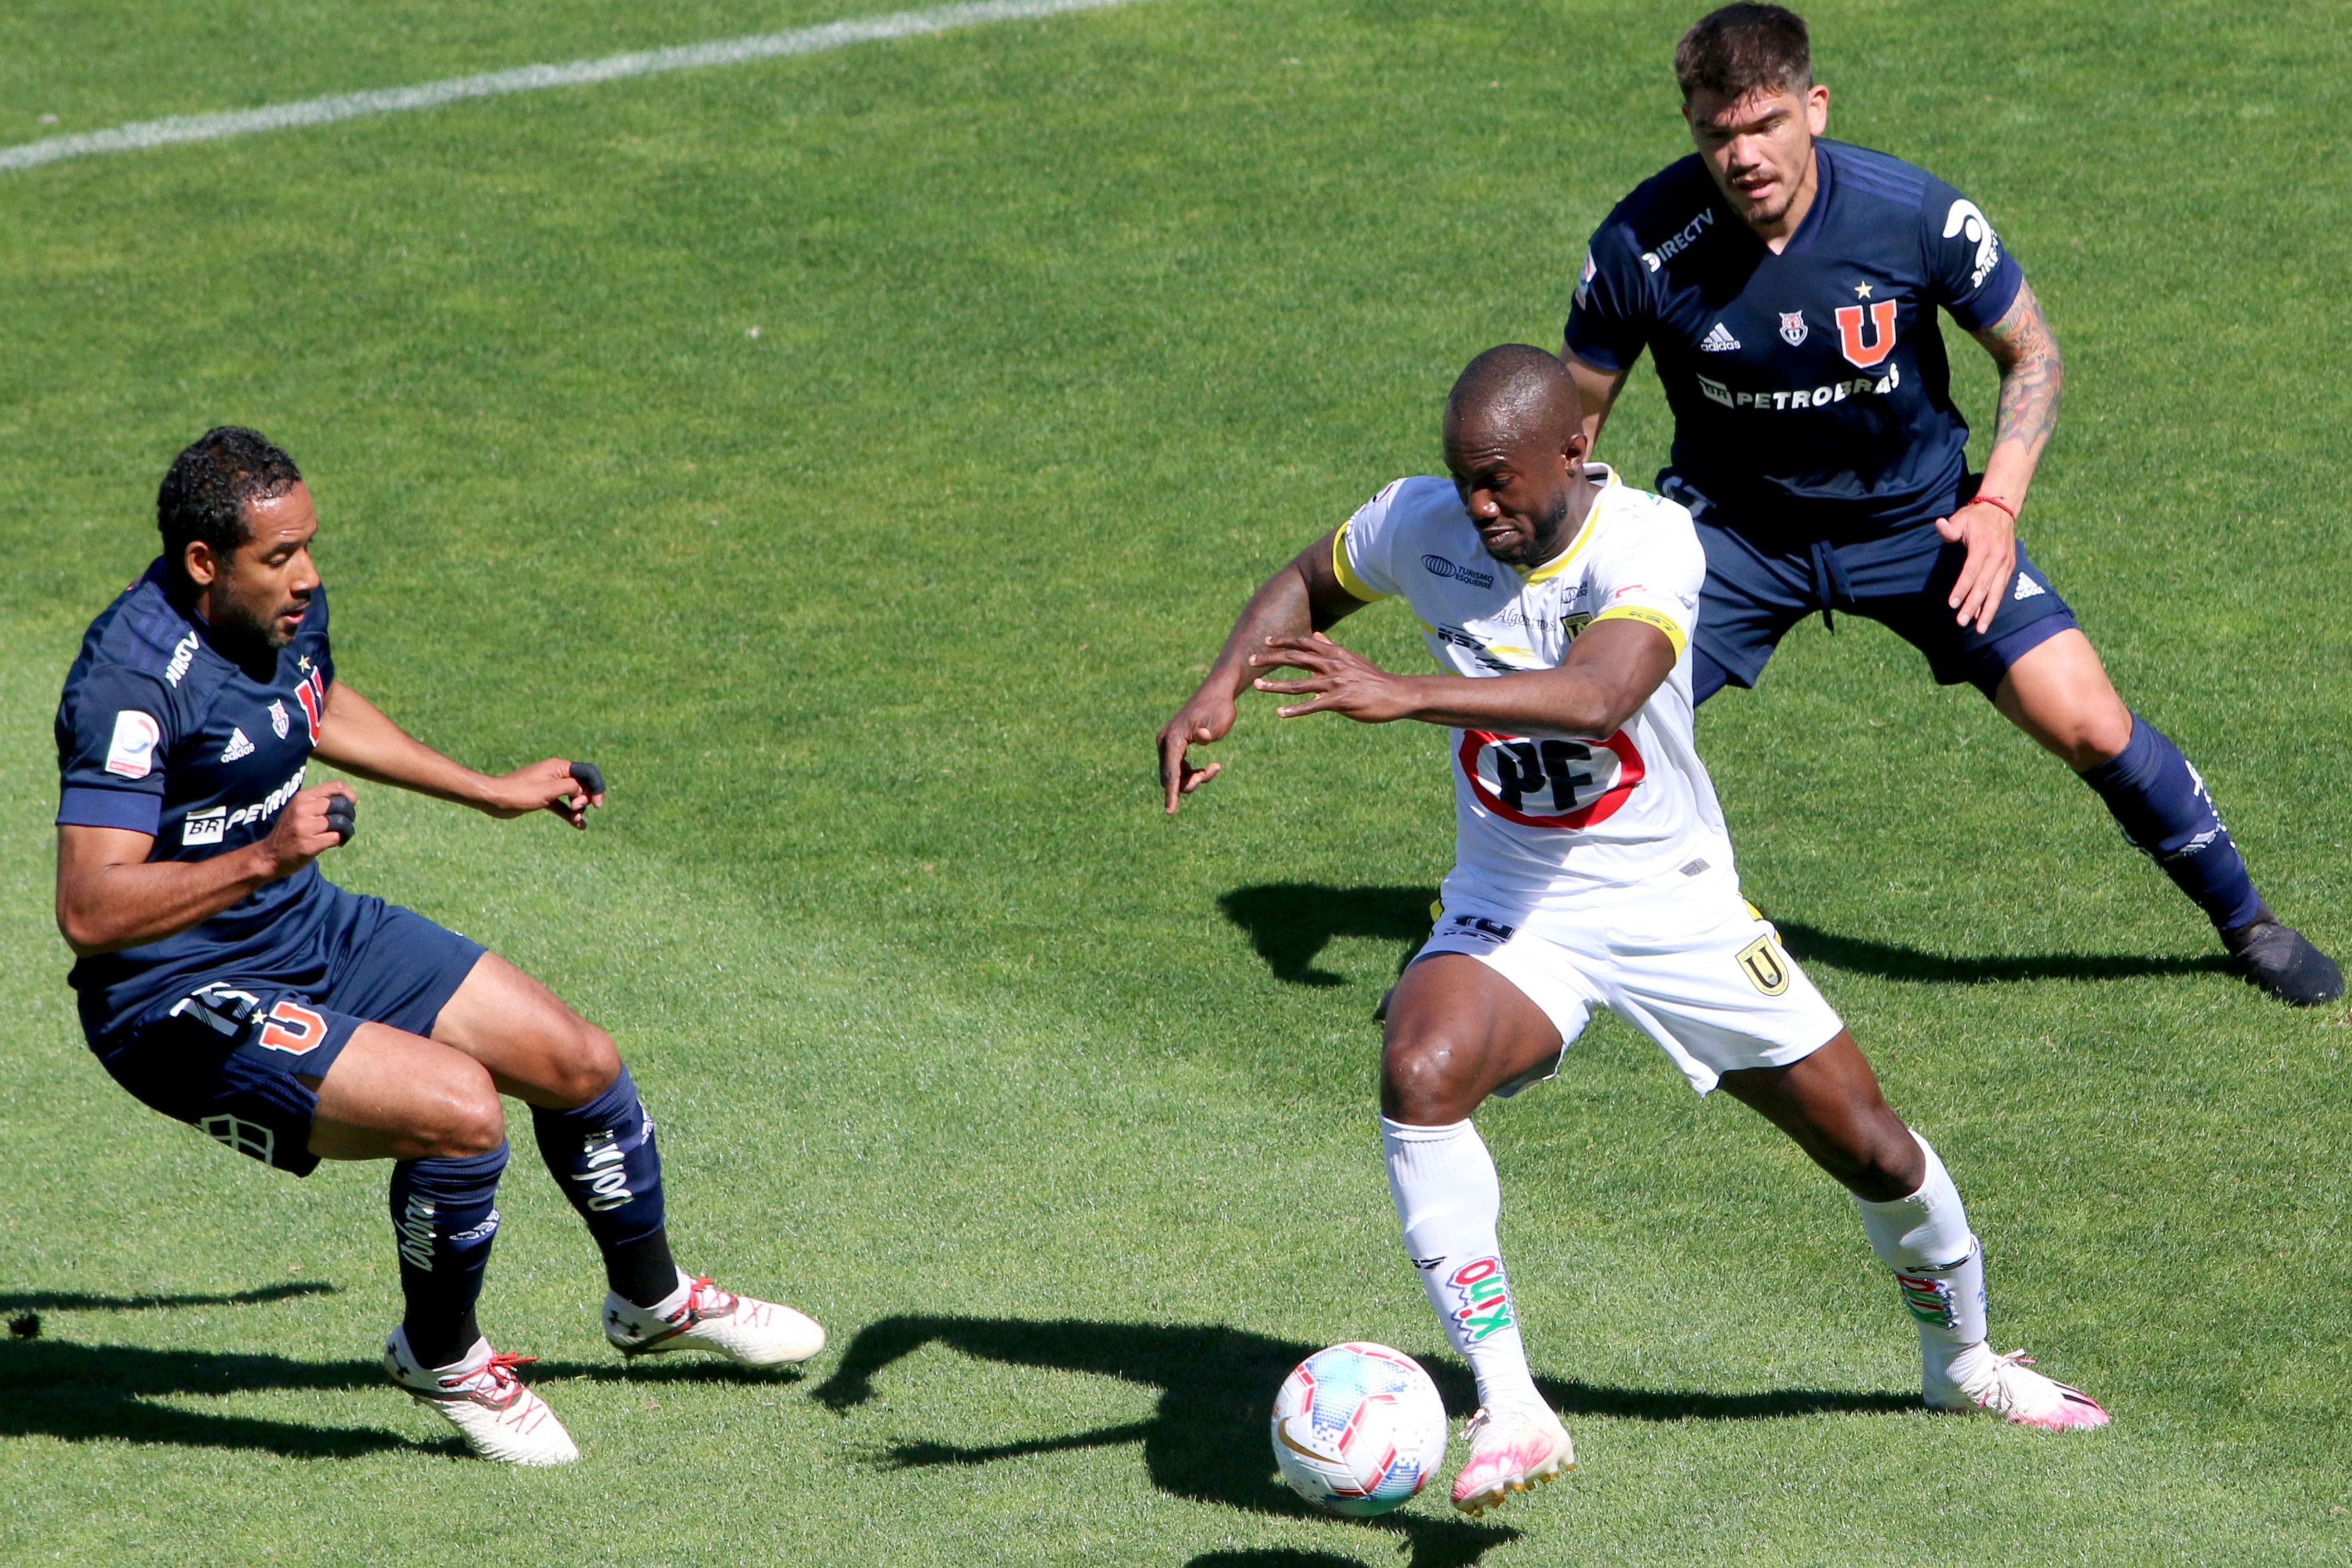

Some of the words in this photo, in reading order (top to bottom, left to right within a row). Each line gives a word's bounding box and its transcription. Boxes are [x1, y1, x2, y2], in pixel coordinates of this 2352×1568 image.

[1641, 207, 1714, 273] DIRECTV
[1700, 340, 1741, 352] adidas
[1835, 299, 1897, 369] U
[1737, 362, 1900, 410] PETROBRAS
[1458, 566, 1495, 583] TURISMO
[221, 742, 255, 763] adidas
[1491, 740, 1593, 811] PF
[189, 820, 220, 835] BR
[1744, 944, 1783, 989] U
[258, 1000, 328, 1056] U
